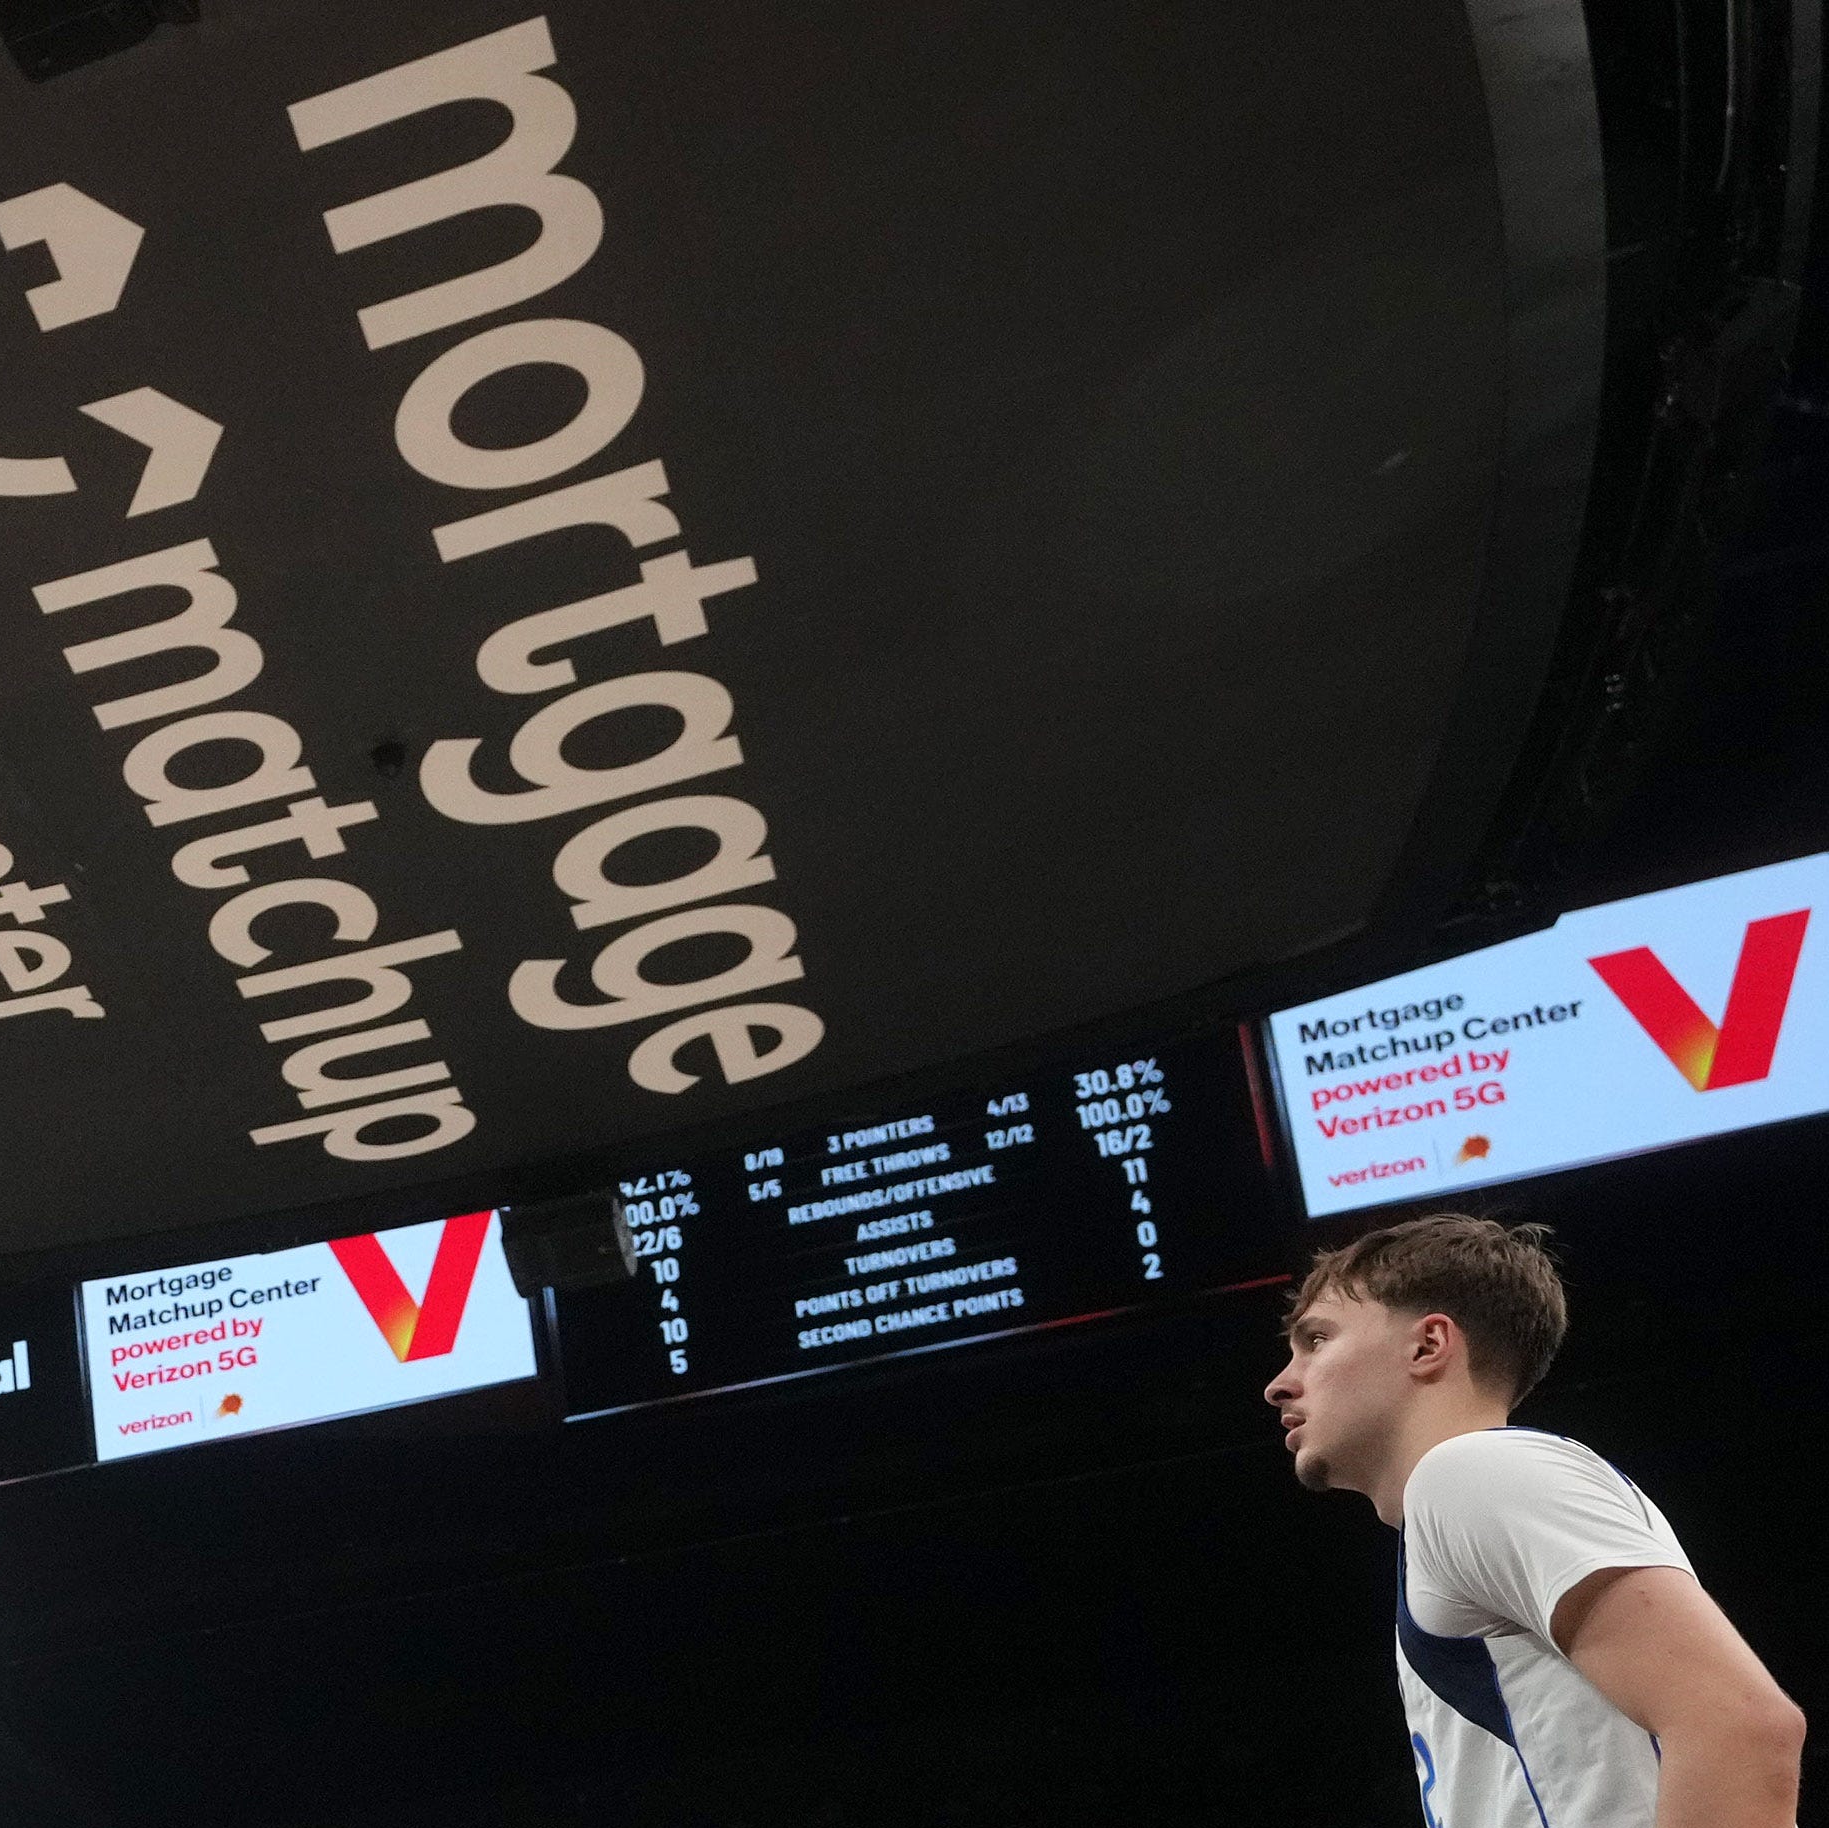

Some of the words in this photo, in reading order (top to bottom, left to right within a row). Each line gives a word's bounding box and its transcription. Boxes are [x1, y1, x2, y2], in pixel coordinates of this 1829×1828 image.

[287, 14, 826, 1095] mortgage
[31, 536, 477, 1162] matchup
[1299, 991, 1465, 1044] Mortgage
[1305, 1028, 1455, 1077] Matchup
[1462, 998, 1585, 1042] Center
[827, 1135, 841, 1154] 3
[843, 1114, 936, 1150] POINTERS
[1073, 1057, 1165, 1099] 30.8%
[1311, 1051, 1462, 1111] powered
[1470, 1046, 1511, 1075] by
[1316, 1096, 1446, 1140] Verizon
[1454, 1082, 1506, 1113] 5G
[748, 1178, 783, 1201] 5/5
[821, 1160, 869, 1187] FREE
[870, 1143, 952, 1174] THROWS
[984, 1124, 1036, 1150] 12/12
[1076, 1087, 1172, 1130] 100.0%
[787, 1165, 997, 1225] REBOUNDS/OFFENSIVE
[1094, 1124, 1154, 1157] 16/2
[1327, 1153, 1427, 1188] verizon
[650, 1257, 681, 1284] 10
[857, 1210, 935, 1243] ASSISTS
[1122, 1157, 1148, 1184] 11
[660, 1288, 680, 1312] 4
[844, 1237, 957, 1276] TURNOVERS
[1131, 1190, 1152, 1214] 4
[106, 1266, 233, 1306] Mortgage
[109, 1299, 224, 1336] Matchup
[230, 1277, 321, 1308] Center
[659, 1317, 689, 1345] 10
[795, 1289, 863, 1319] POINTS
[865, 1280, 901, 1304] OFF
[903, 1257, 1018, 1295] TURNOVERS
[1137, 1221, 1157, 1247] 0
[669, 1349, 688, 1374] 5
[798, 1319, 873, 1349] SECOND
[875, 1303, 951, 1334] CHANCE
[953, 1288, 1024, 1318] POINTS
[1142, 1253, 1164, 1280] 2
[110, 1321, 227, 1366] powered
[233, 1317, 263, 1338] by
[113, 1358, 212, 1392] Verizon
[218, 1346, 257, 1371] 5G
[118, 1409, 193, 1435] verizon
